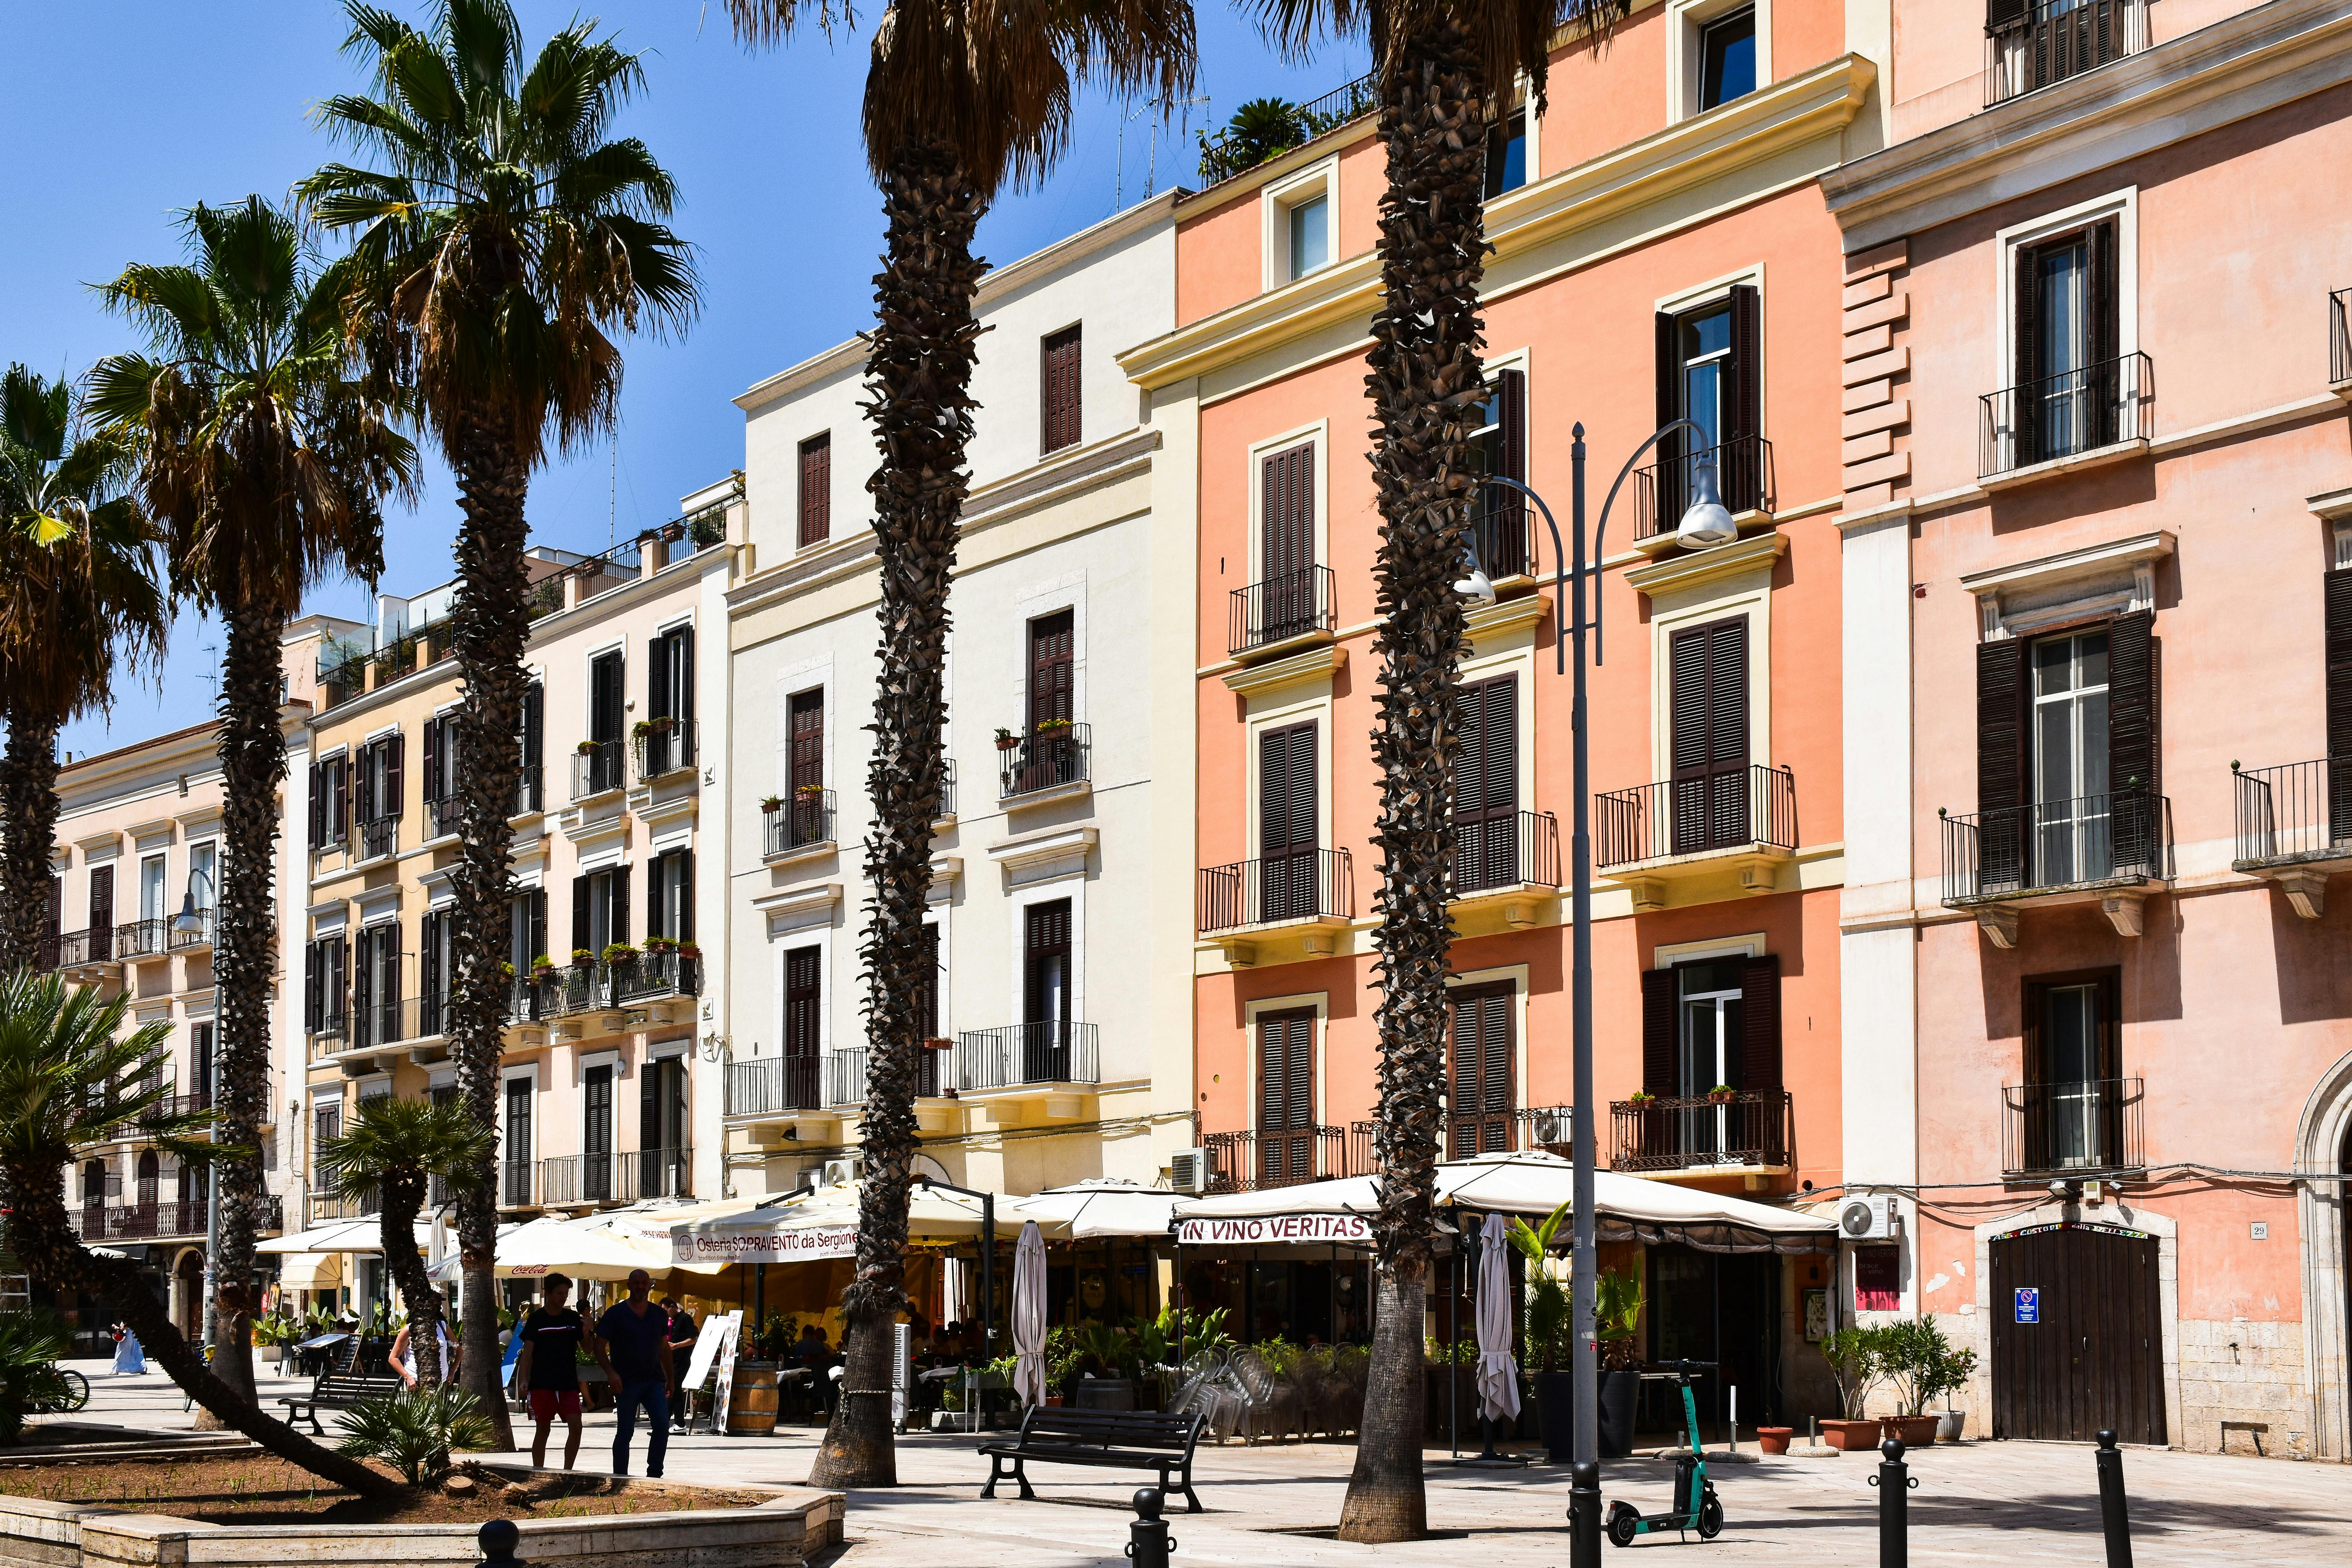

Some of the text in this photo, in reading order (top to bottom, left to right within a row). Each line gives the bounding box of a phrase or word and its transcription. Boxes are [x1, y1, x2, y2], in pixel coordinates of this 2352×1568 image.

[639, 1230, 672, 1239] PESCHERI
[1184, 1217, 1364, 1240] IN VINO VERITAS
[2092, 1225, 2148, 1239] BELLEZZA
[697, 1230, 858, 1252] Osteria SOPRAVENTO da Sergione
[512, 1264, 550, 1274] Coca-Cola
